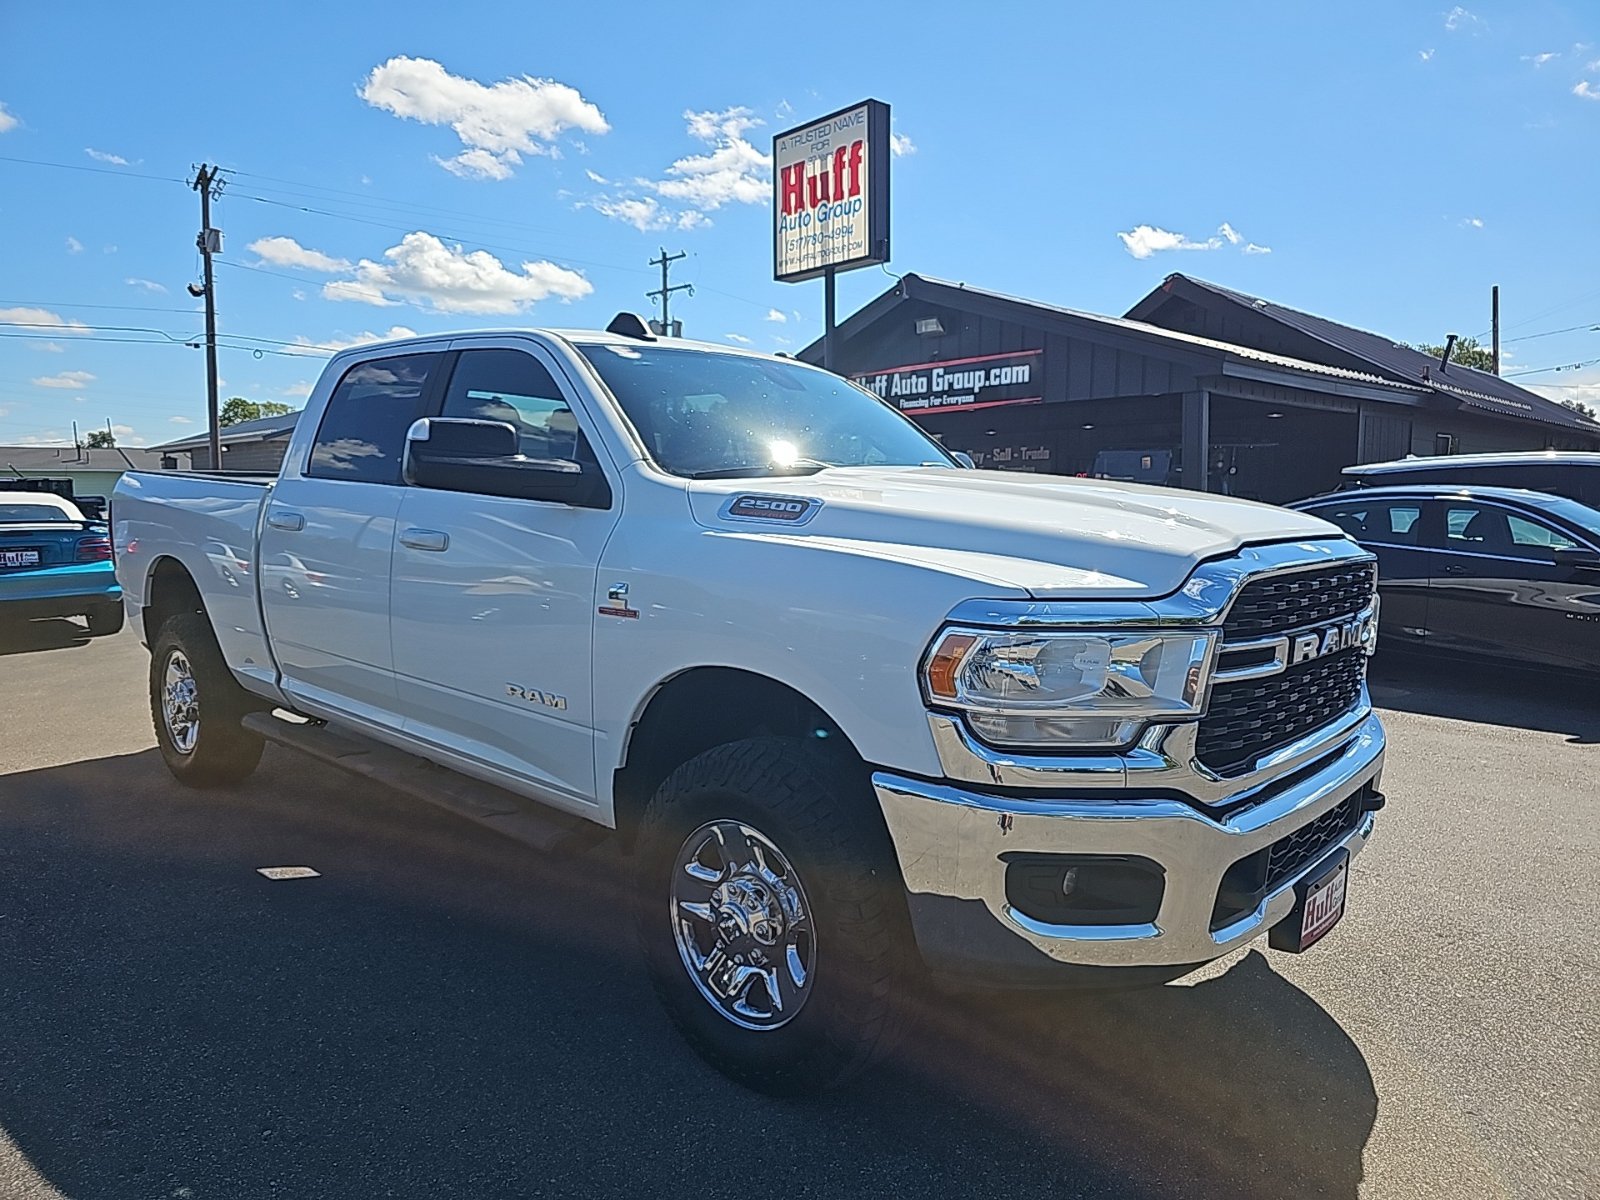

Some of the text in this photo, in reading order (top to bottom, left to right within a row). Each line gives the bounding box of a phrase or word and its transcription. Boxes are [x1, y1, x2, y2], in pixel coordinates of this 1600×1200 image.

[780, 110, 865, 153] A TRUSTED NAME
[810, 139, 830, 153] FOR
[780, 139, 863, 216] Huff
[779, 198, 862, 234] Auto Group
[891, 373, 928, 396] Auto
[932, 364, 1030, 393] Group.com
[900, 394, 975, 409] Financing For Everyone
[993, 447, 1012, 461] Sell
[1020, 446, 1050, 460] Trade
[739, 499, 803, 512] 2500
[1293, 621, 1362, 665] RAM
[505, 681, 567, 710] RAM
[1304, 881, 1335, 933] Huff
